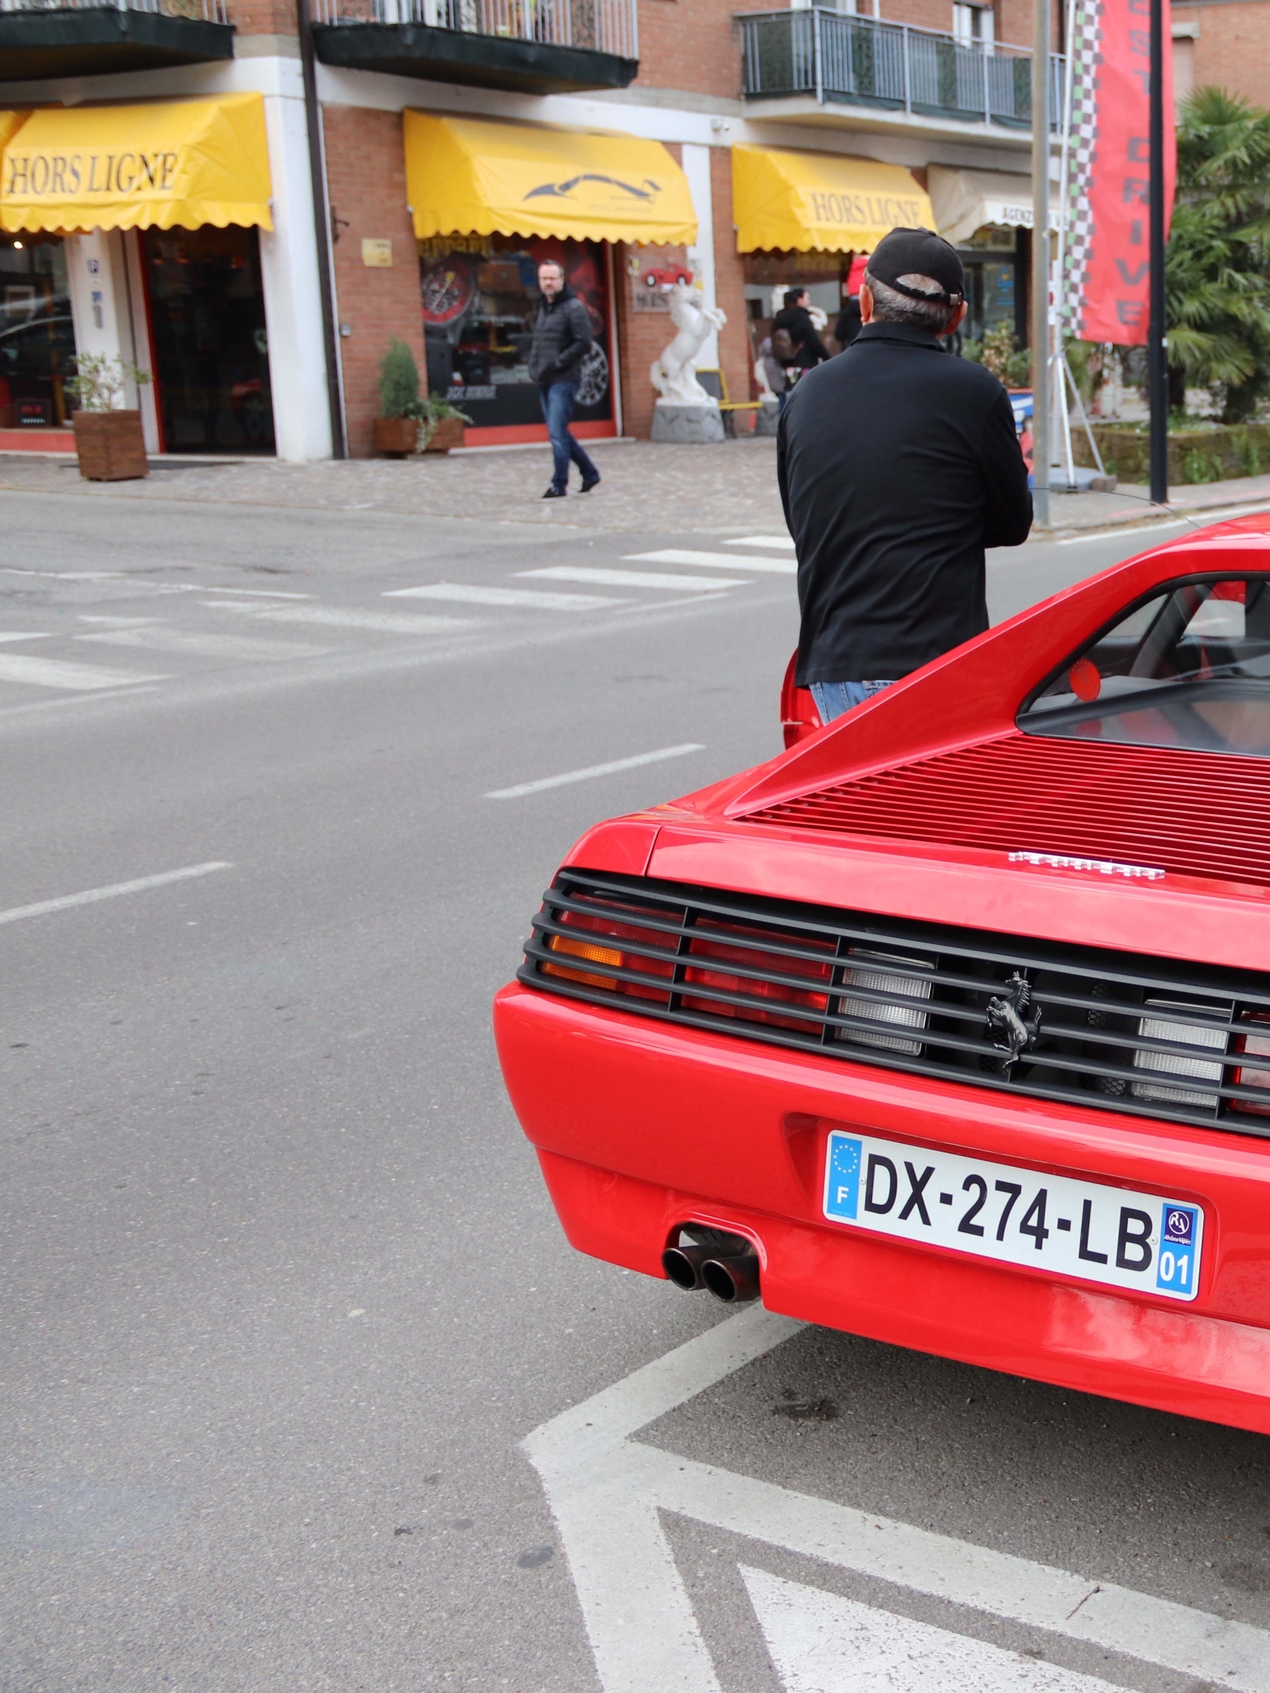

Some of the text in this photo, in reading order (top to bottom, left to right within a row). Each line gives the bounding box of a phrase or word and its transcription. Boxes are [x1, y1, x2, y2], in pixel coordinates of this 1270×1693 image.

[6, 152, 177, 195] HORS LIGNE
[811, 192, 922, 229] HORS LIGNE
[1113, 136, 1150, 327] DRIVE
[837, 1186, 849, 1204] F
[864, 1153, 1154, 1272] DX-274-LB
[1160, 1251, 1188, 1285] 01
